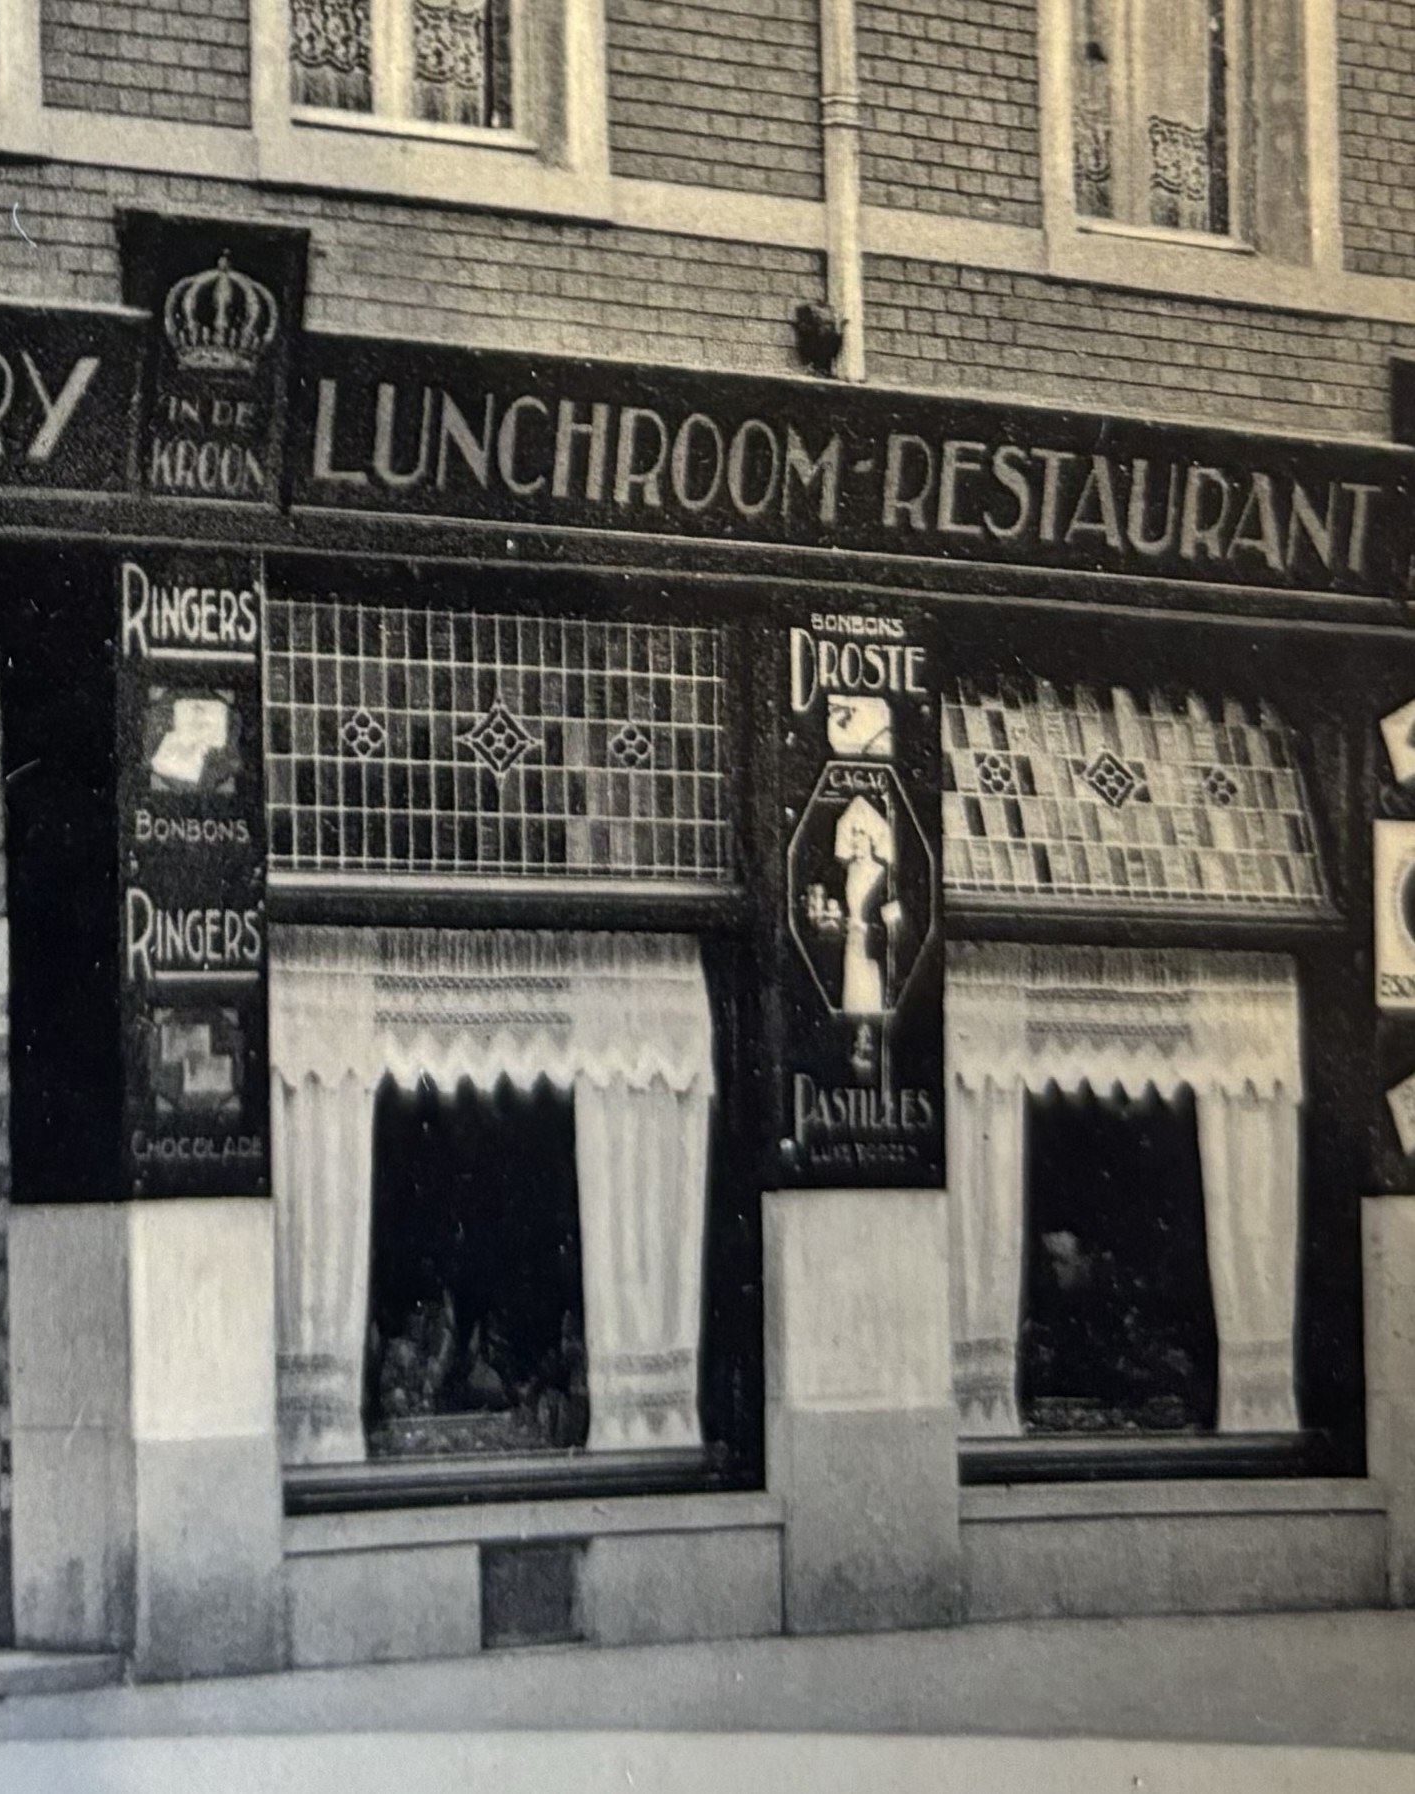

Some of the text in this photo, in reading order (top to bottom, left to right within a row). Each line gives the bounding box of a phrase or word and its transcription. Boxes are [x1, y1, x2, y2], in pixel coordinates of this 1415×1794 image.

[168, 395, 255, 428] IN DE
[151, 437, 267, 494] KROON
[810, 612, 906, 638] BONBONS
[789, 627, 927, 714] DROSTE
[134, 809, 250, 843] BONBONS
[793, 1072, 933, 1146] PASTILLES
[130, 1128, 264, 1167] CHOCOLADE
